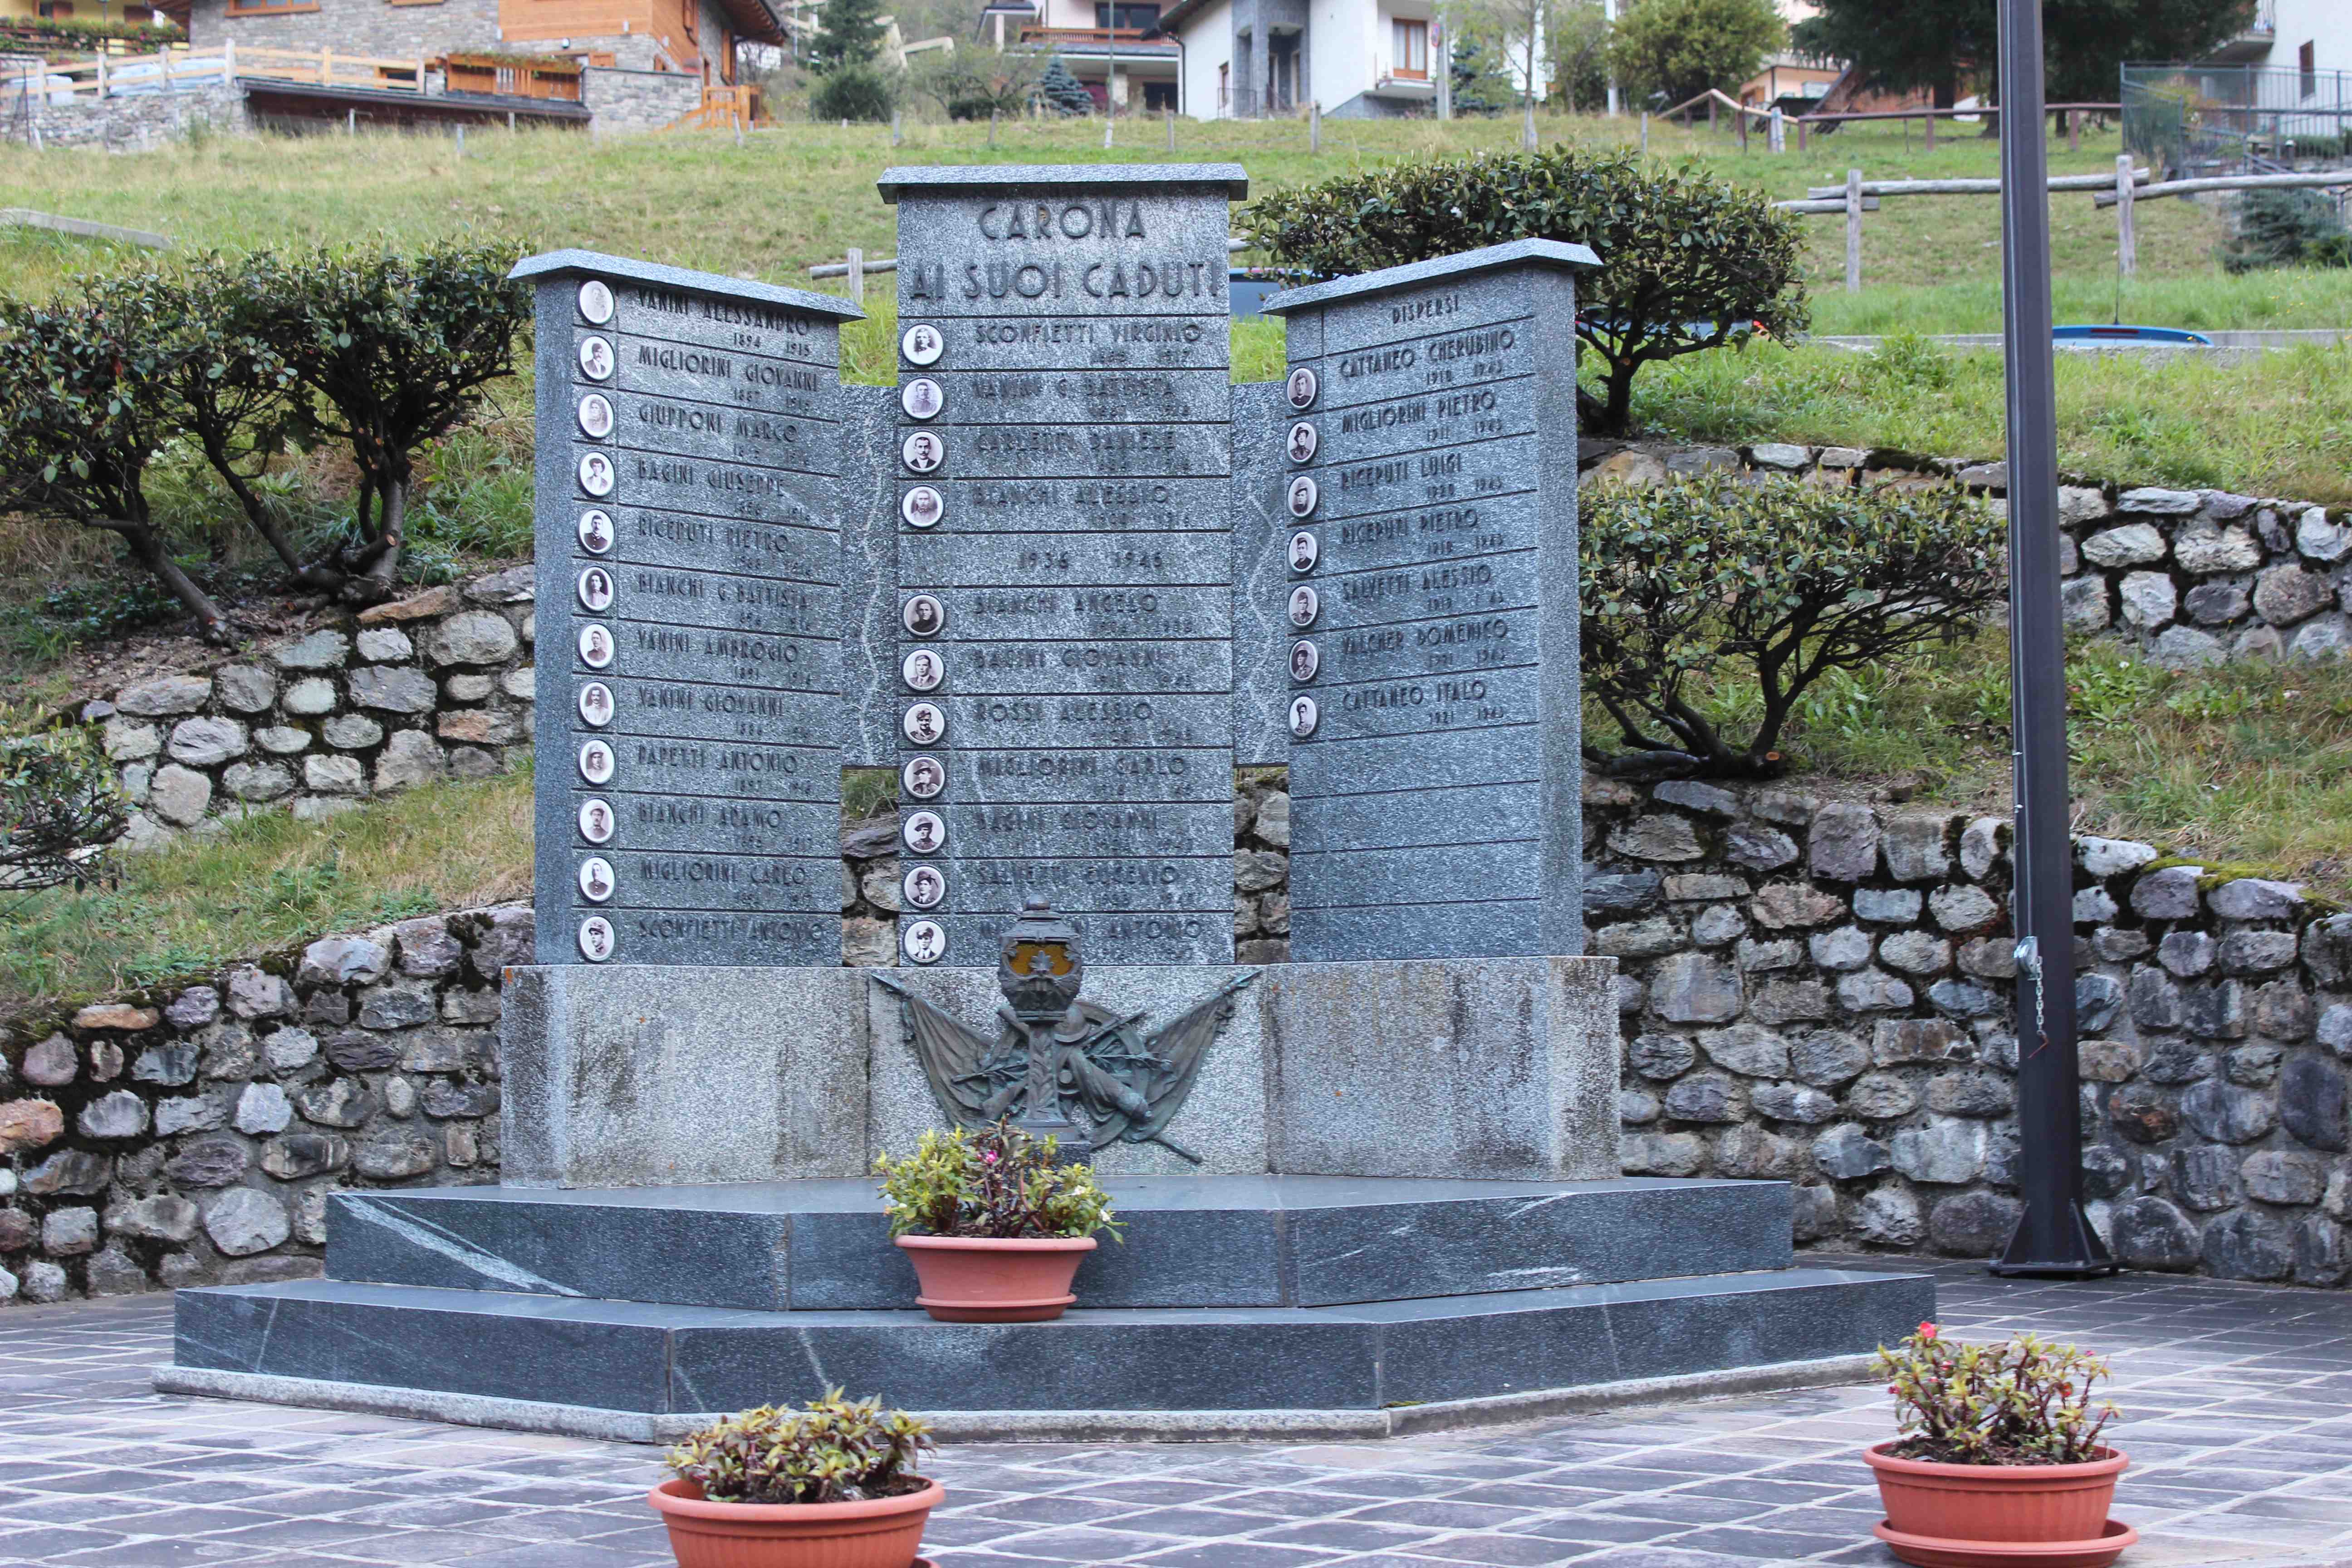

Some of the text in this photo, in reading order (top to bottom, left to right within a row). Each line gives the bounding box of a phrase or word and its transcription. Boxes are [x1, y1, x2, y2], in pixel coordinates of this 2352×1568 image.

[978, 204, 1145, 240] CARONA
[910, 261, 1217, 299] AI SUOI CADUTI
[638, 288, 810, 336] VANINI ALESSANDRO
[1392, 294, 1459, 324] DISPERSI
[734, 333, 810, 356] 1894 1915
[975, 323, 1202, 343] SCONFIETTI VIRGINIO
[639, 345, 817, 392] MIGLIORINI GIOVANNI
[1340, 329, 1515, 378] CATTANEO CHERUBINO
[640, 404, 798, 442] GIUPPONI MARCO
[1342, 391, 1496, 434] MIGLIORINI PIETRO
[639, 459, 784, 497] BAGINI GIUSEPPE
[1341, 453, 1461, 491] RICEPUTI LUIGI
[1074, 485, 1169, 505] ALESSIO
[639, 515, 789, 553] RICEPUTI PIETRO
[1342, 509, 1479, 544] RICEPUTI PIETRO
[639, 573, 703, 598] BIANCHI
[738, 584, 808, 609] BATTISTA
[1343, 564, 1491, 603] SALVETTI ALESSIO
[1075, 593, 1156, 614] ANGELO
[637, 629, 799, 663] VANINI AMBROGIO
[1416, 618, 1509, 646] DOMENICO
[639, 687, 784, 717] VANINI GIOVANNI
[1343, 680, 1486, 711] CATTANEO ITALO
[1060, 702, 1152, 721] ALESSIO
[639, 745, 797, 774] PAPETTI ANTONIO
[1116, 756, 1185, 775] CARLO
[639, 802, 781, 828] BIANCHI ADAMO
[641, 860, 805, 886] MIGLIORINI CARLO
[1085, 865, 1180, 885] EUGENIO
[638, 918, 734, 939] SCONFIETTI
